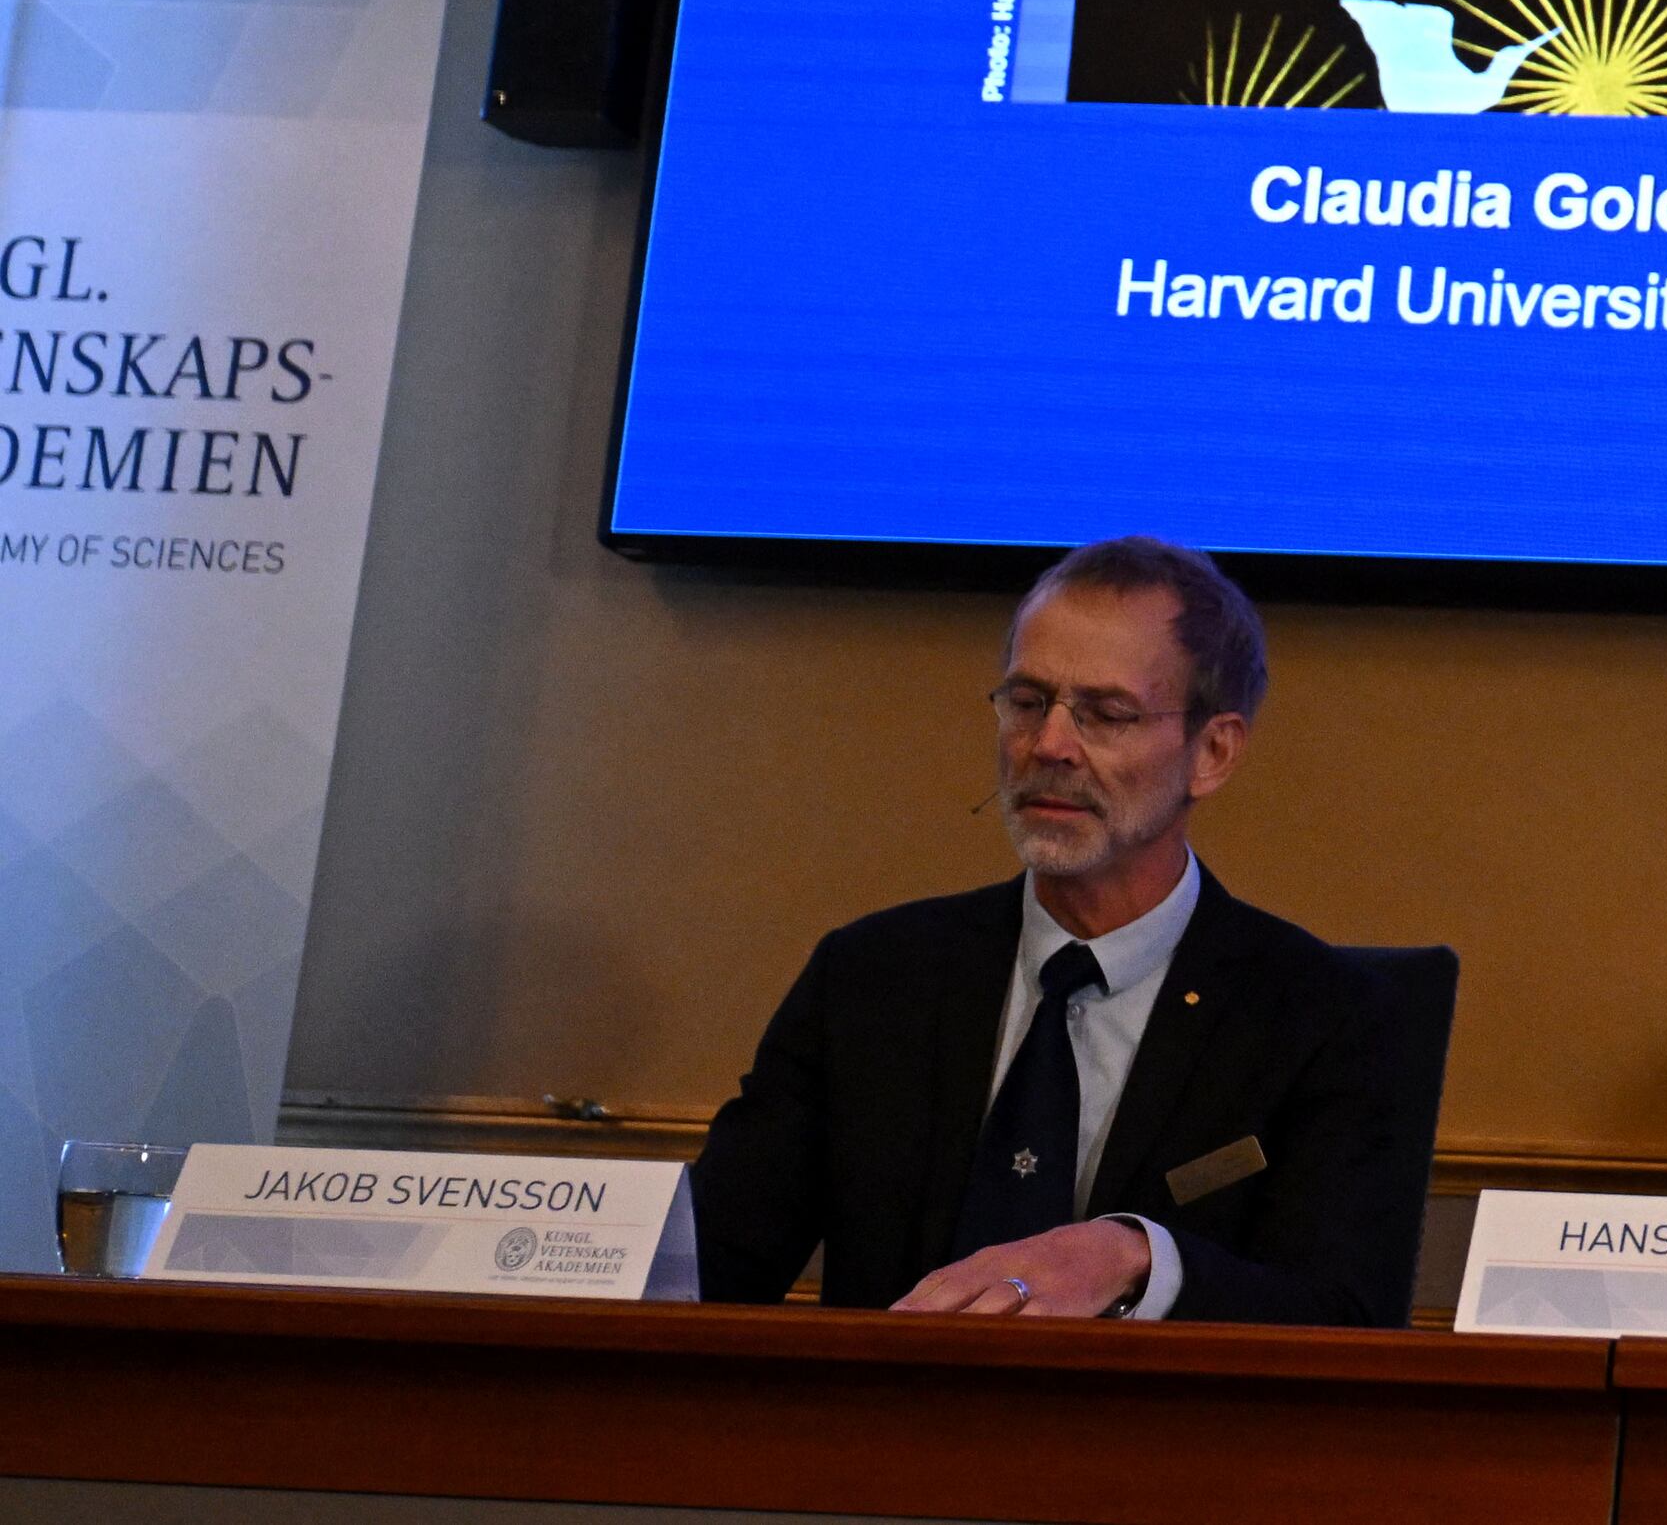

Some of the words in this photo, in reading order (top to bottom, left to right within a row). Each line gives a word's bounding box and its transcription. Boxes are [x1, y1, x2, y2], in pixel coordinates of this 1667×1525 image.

[981, 24, 1011, 103] Photo:
[1251, 166, 1511, 228] Claudia
[1117, 259, 1374, 322] Harvard
[0, 330, 333, 404] NSKAPS-
[57, 534, 104, 567] OF
[111, 536, 285, 575] SCIENCES
[245, 1170, 378, 1205] JAKOB
[388, 1175, 607, 1213] SVENSSON
[534, 1260, 623, 1274] AKADEMIEN
